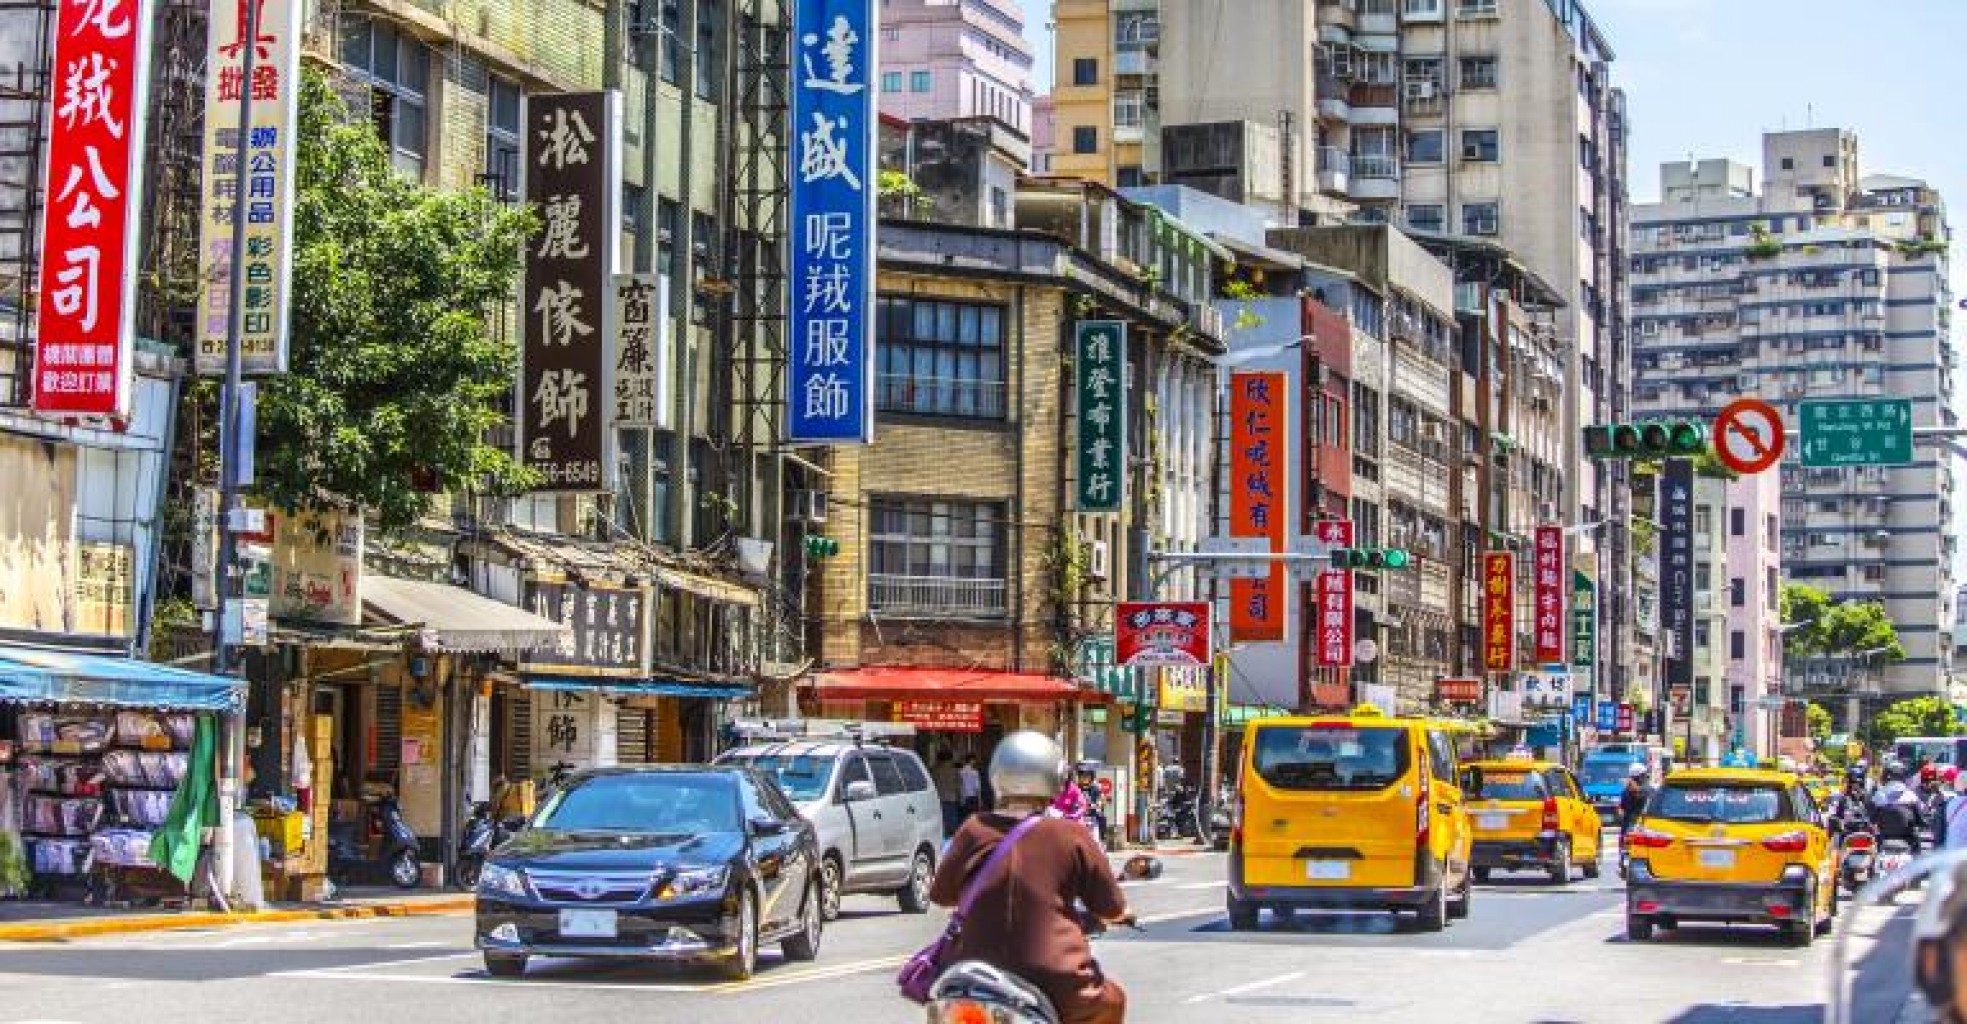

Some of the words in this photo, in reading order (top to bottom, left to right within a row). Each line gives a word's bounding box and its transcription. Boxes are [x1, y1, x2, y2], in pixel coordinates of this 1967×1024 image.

[248, 126, 277, 223] 辦公用品
[246, 236, 274, 333] 彩色影印
[533, 108, 597, 437] 淞麗傢飾
[619, 278, 656, 374] 窗簾
